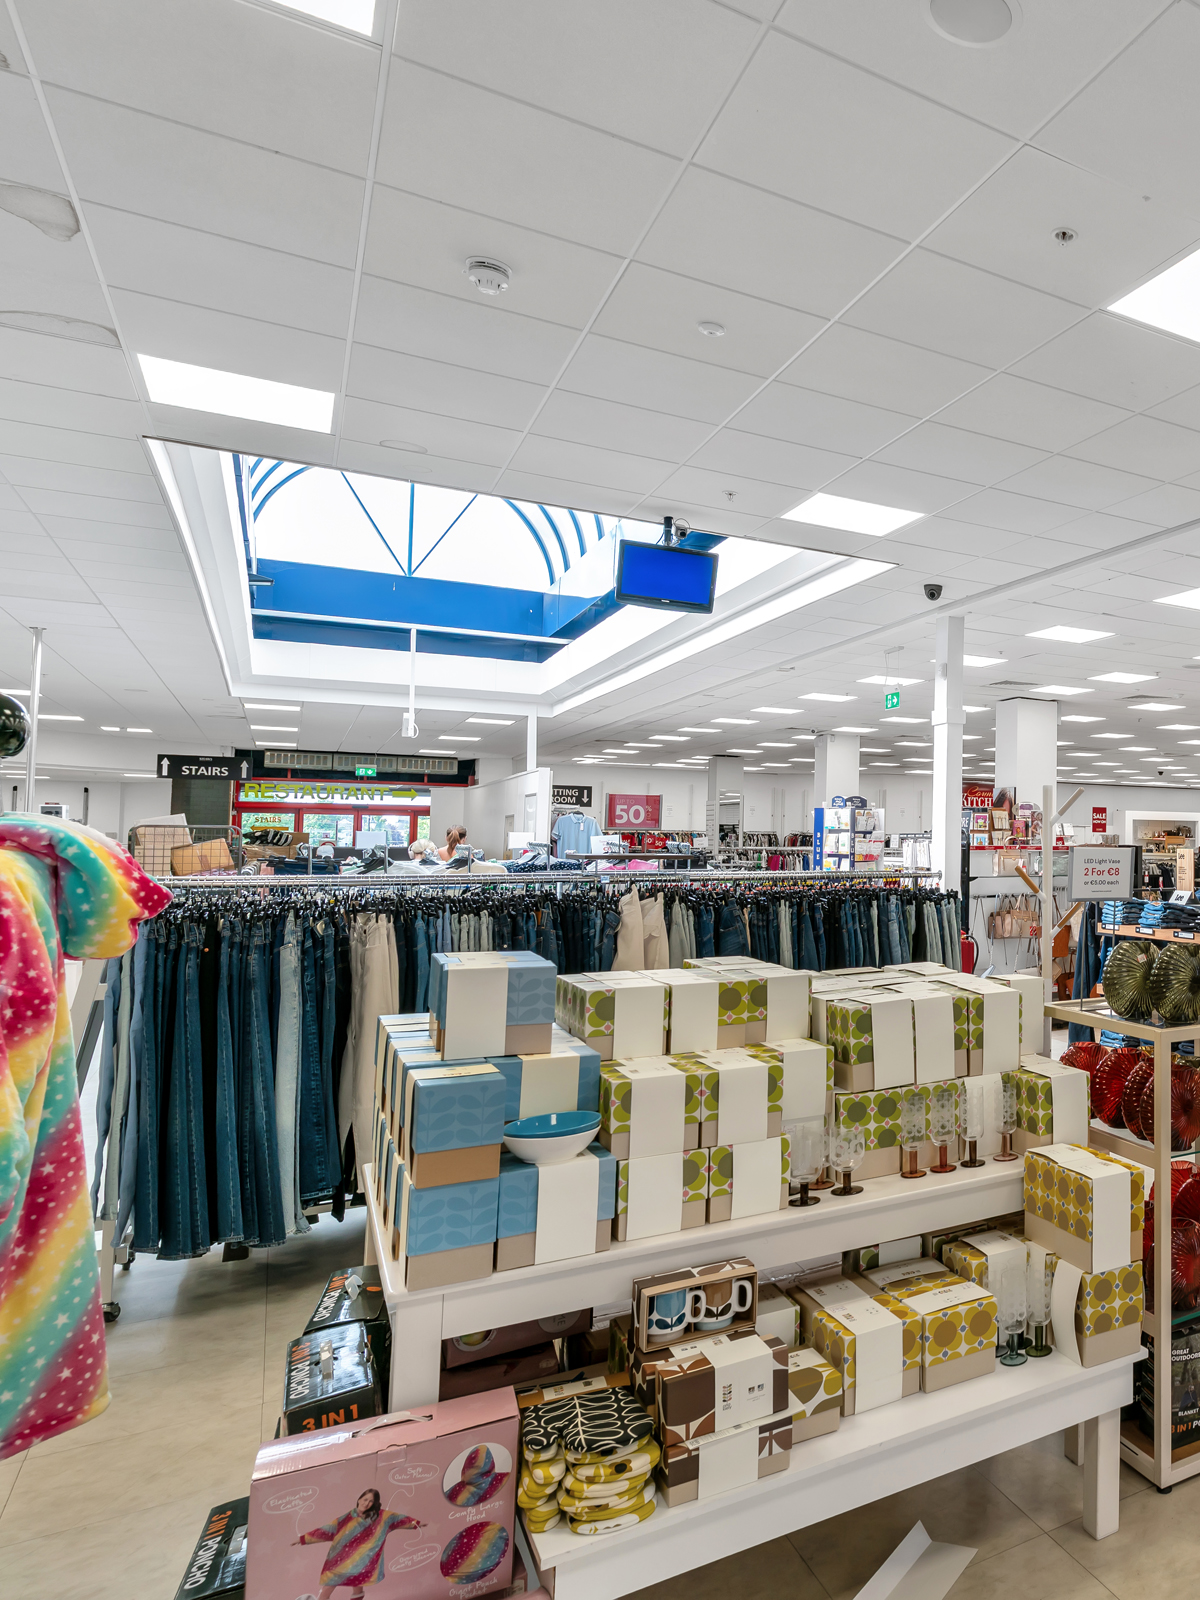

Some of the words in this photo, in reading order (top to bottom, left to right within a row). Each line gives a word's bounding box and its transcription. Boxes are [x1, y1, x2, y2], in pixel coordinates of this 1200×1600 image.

[181, 765, 229, 776] STAIRS
[244, 783, 390, 801] RESTAURANT
[552, 788, 579, 796] TTING
[961, 793, 994, 808] KITCH
[254, 816, 282, 824] STAIRS
[1095, 858, 1108, 866] Light
[1084, 867, 1090, 876] 2
[1091, 867, 1106, 876] For
[1107, 867, 1120, 876] €8
[1175, 894, 1185, 902] Lee
[312, 1289, 342, 1322] PONCHO
[291, 1342, 311, 1352] 3
[289, 1361, 310, 1399] PONCHO
[302, 1417, 316, 1433] 3
[321, 1408, 345, 1428] IN
[350, 1403, 359, 1420] 1
[1178, 1408, 1199, 1417] BLANKET
[1177, 1424, 1187, 1433] IN
[1188, 1422, 1192, 1430] 1
[270, 1488, 313, 1507] Elasticated
[211, 1510, 233, 1521] 3
[448, 1506, 476, 1520] Comfy
[480, 1500, 505, 1511] Large
[466, 1510, 486, 1522] Hood
[206, 1518, 229, 1535] IN
[203, 1529, 225, 1541] 1
[183, 1535, 223, 1590] PONCHO
[449, 1584, 473, 1597] Giant
